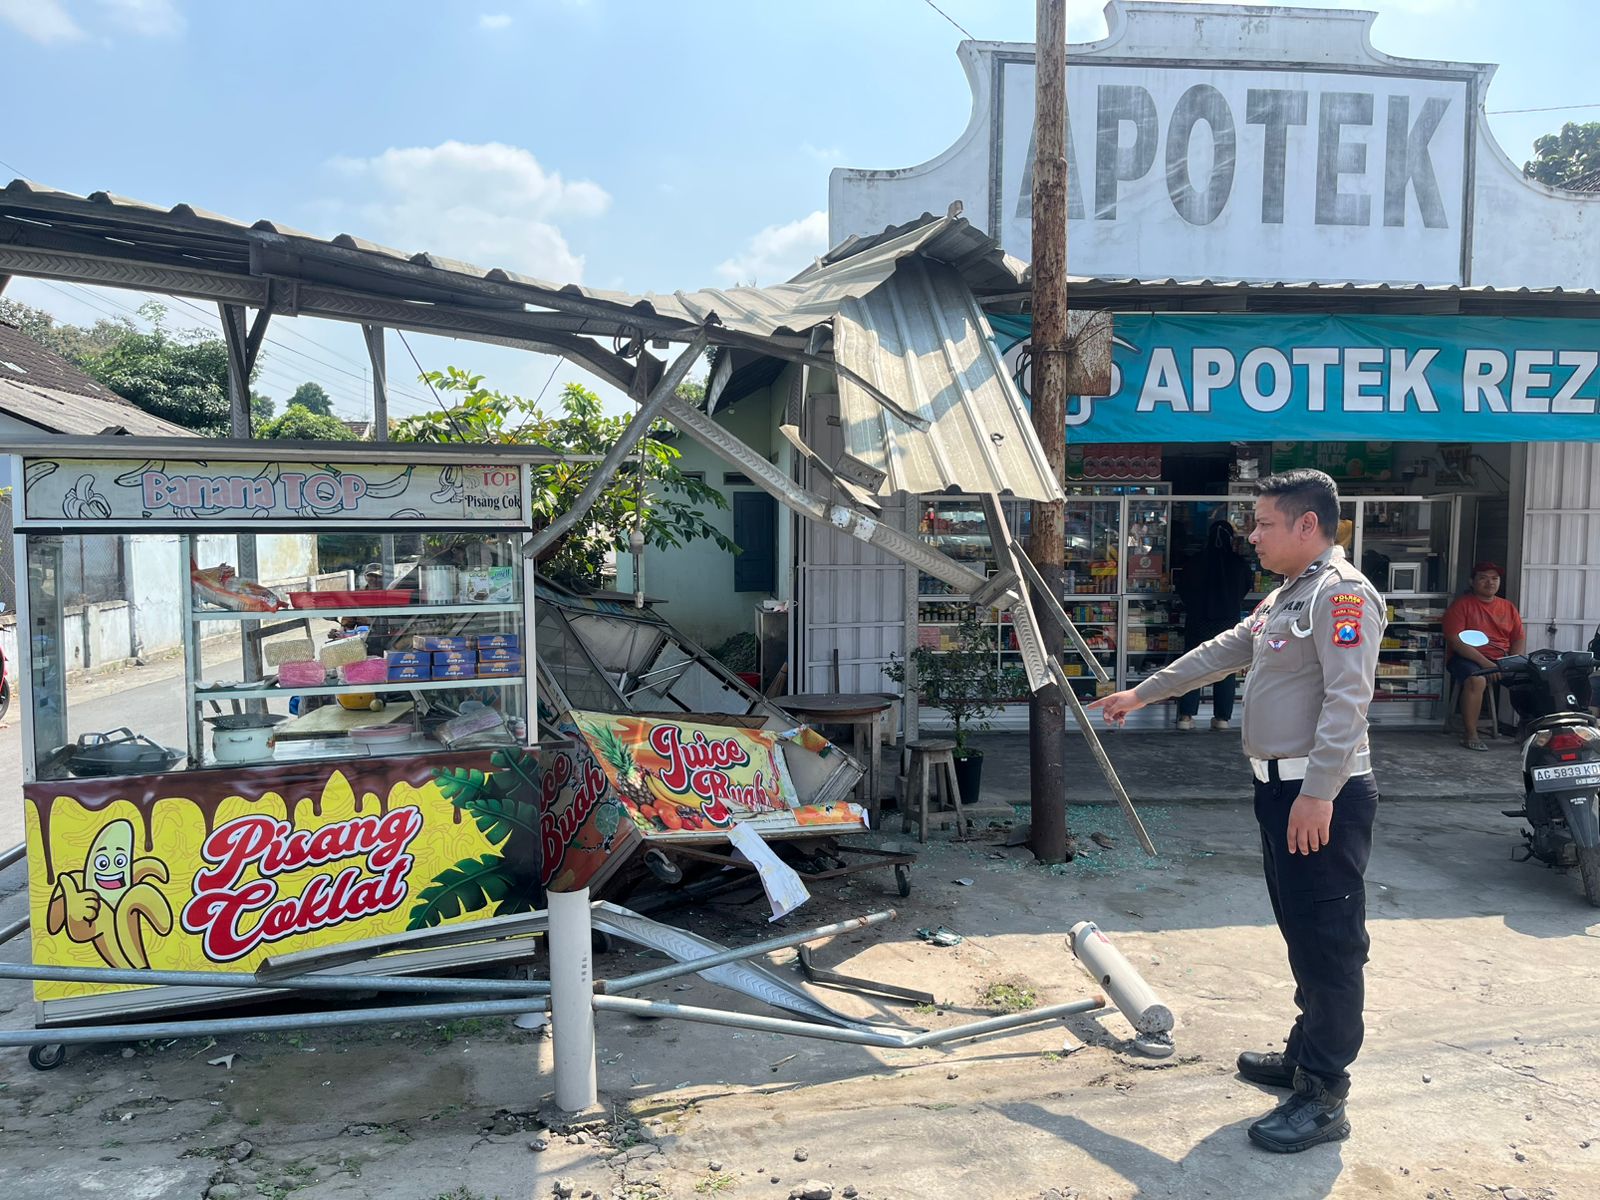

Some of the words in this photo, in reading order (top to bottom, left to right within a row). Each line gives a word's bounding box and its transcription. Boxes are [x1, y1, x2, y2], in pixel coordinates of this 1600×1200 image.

[1015, 83, 1452, 229] APOTEK
[1136, 346, 1440, 413] APOTEK
[141, 471, 276, 509] Banana
[279, 473, 368, 510] TOP
[465, 494, 500, 511] Pisang
[483, 471, 517, 487] TOP
[649, 722, 750, 795] Juice
[1553, 766, 1581, 778] 5839
[1583, 763, 1600, 776] KD
[191, 805, 423, 893] Pisang
[541, 756, 608, 887] Buah
[180, 853, 415, 964] Coklat
